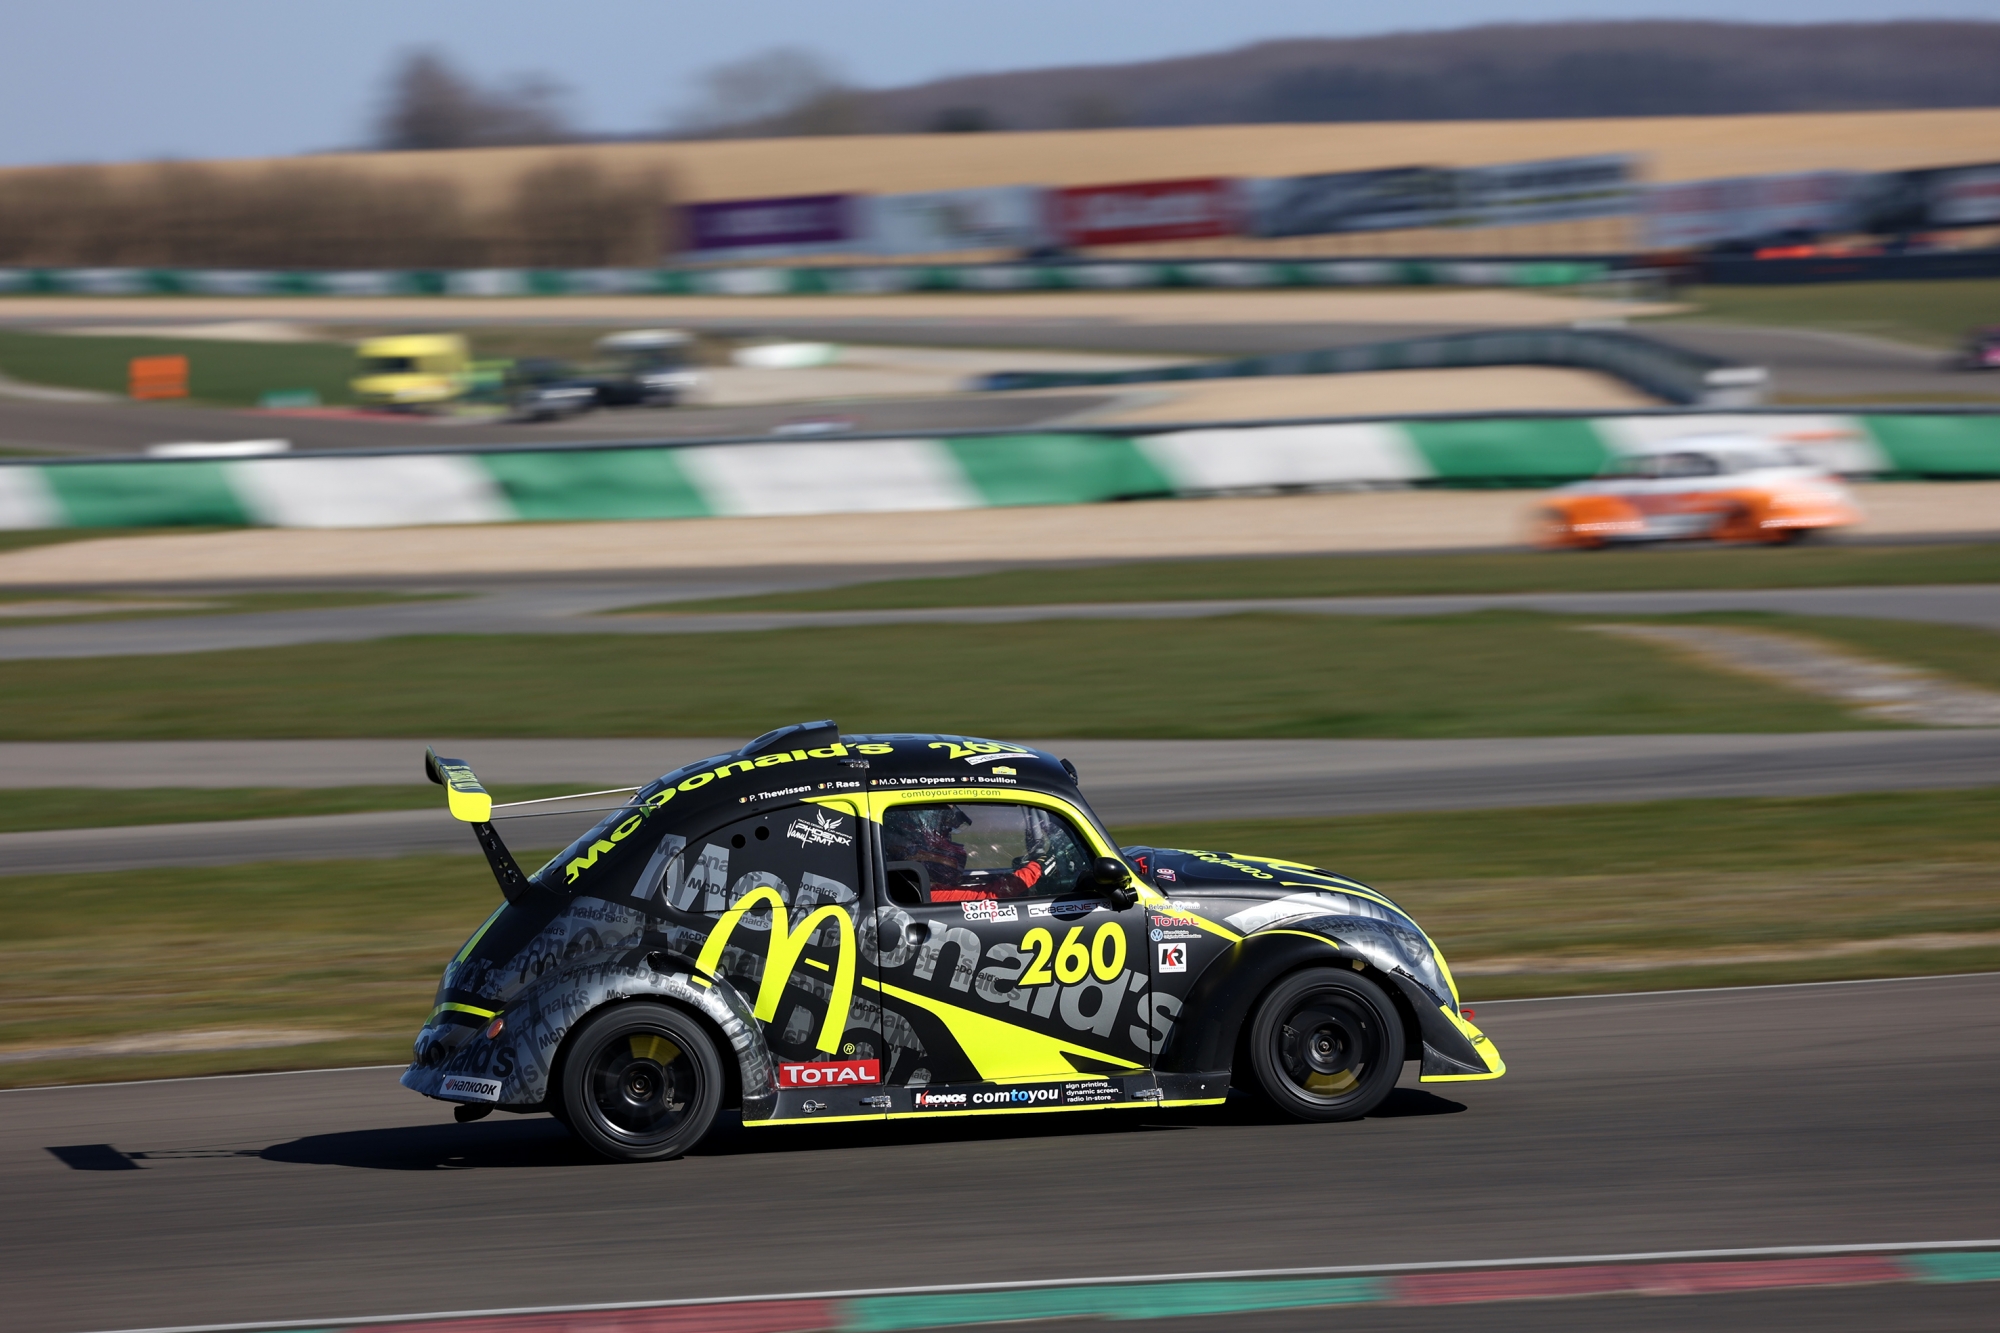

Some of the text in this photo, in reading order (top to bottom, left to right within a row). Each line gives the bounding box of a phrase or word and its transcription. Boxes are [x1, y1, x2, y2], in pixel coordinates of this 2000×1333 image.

[826, 780, 860, 789] P. Raes
[879, 776, 956, 786] M.O. Van Oppens
[978, 776, 1017, 784] Bouillon
[749, 785, 812, 802] P. Thewissen
[901, 788, 1001, 799] comtoyouracing.com
[565, 742, 895, 885] McDonald's
[795, 822, 852, 847] PHOENIX
[965, 906, 1016, 921] compact
[1151, 916, 1199, 927] TOTAL
[1018, 921, 1127, 987] 260
[784, 1066, 876, 1084] TOTAL
[915, 1090, 967, 1104] KRONOS
[972, 1087, 1059, 1104] comtoyou
[1066, 1089, 1095, 1097] dynamic
